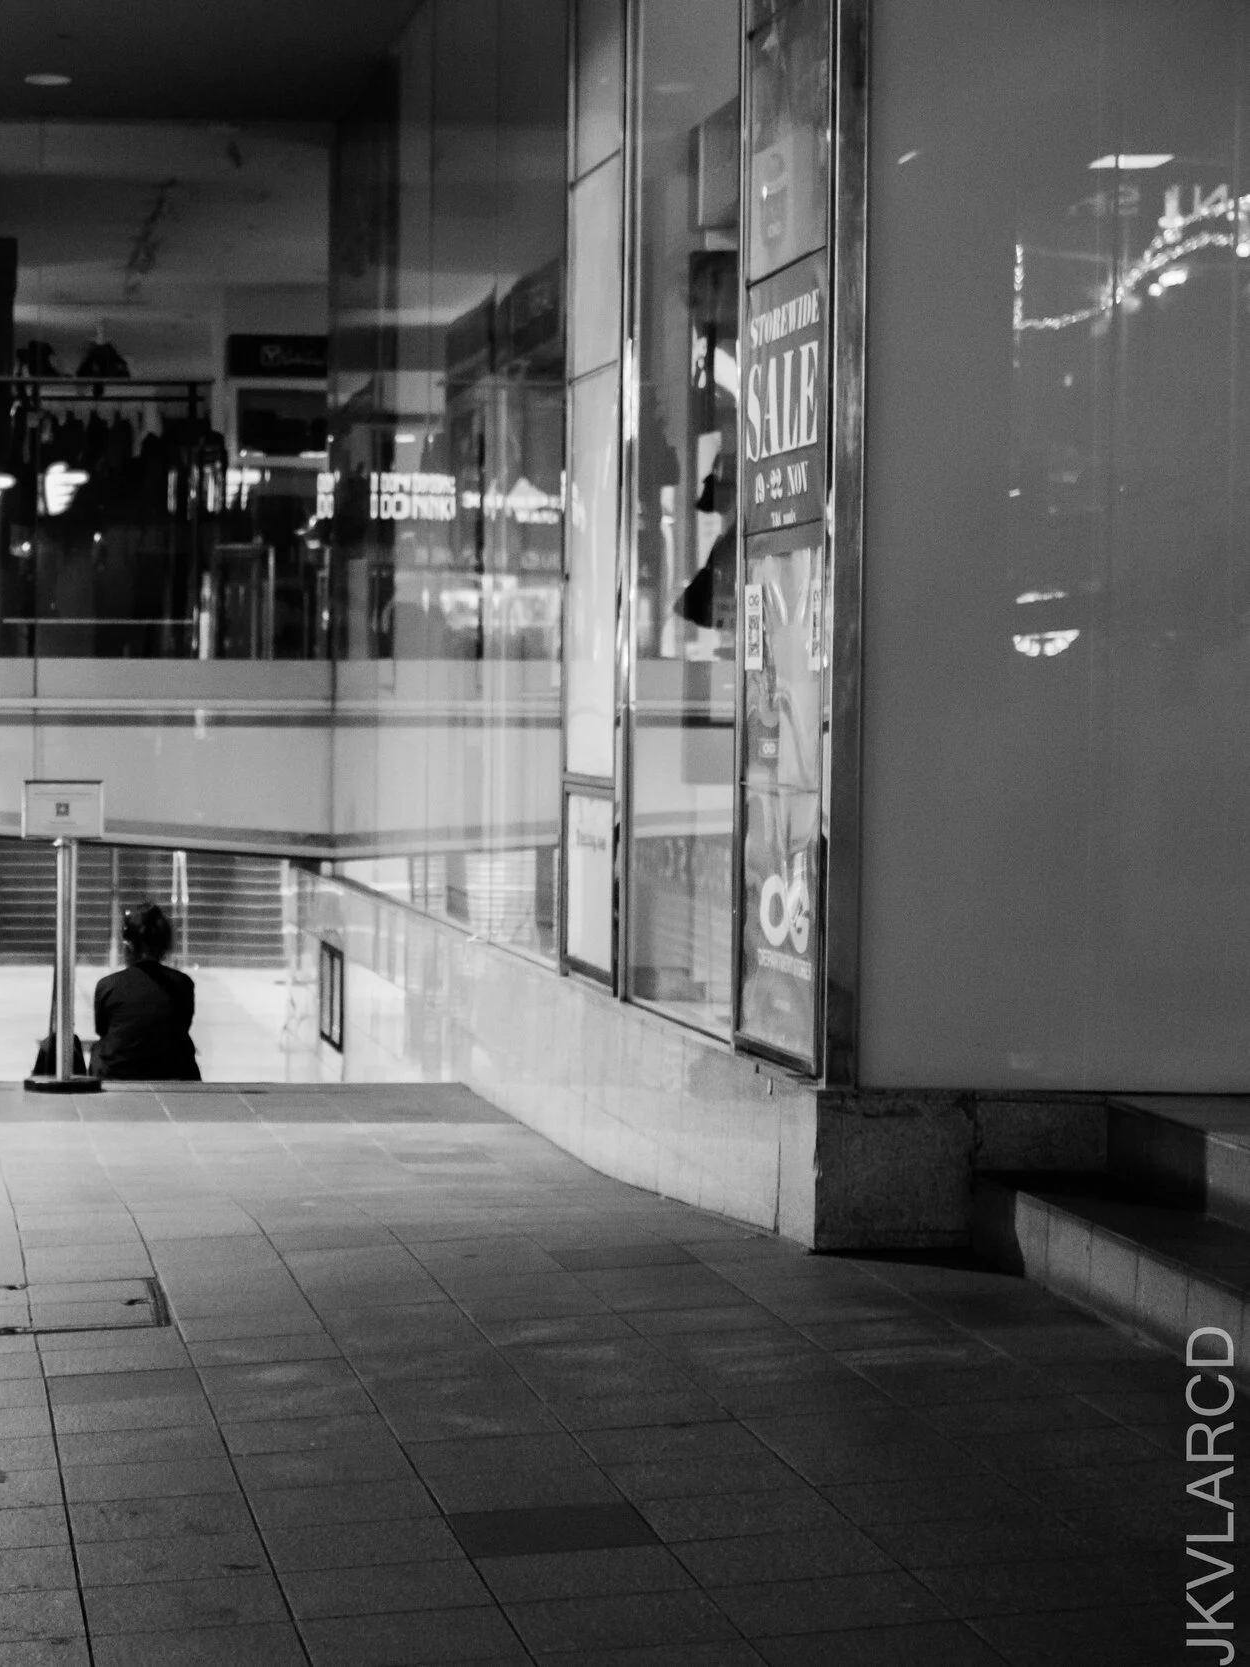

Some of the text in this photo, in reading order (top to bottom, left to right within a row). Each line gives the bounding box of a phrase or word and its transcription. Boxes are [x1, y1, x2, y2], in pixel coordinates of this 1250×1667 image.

[750, 288, 820, 349] STOREWIDE
[746, 340, 819, 463] SALE
[787, 460, 809, 497] NOV
